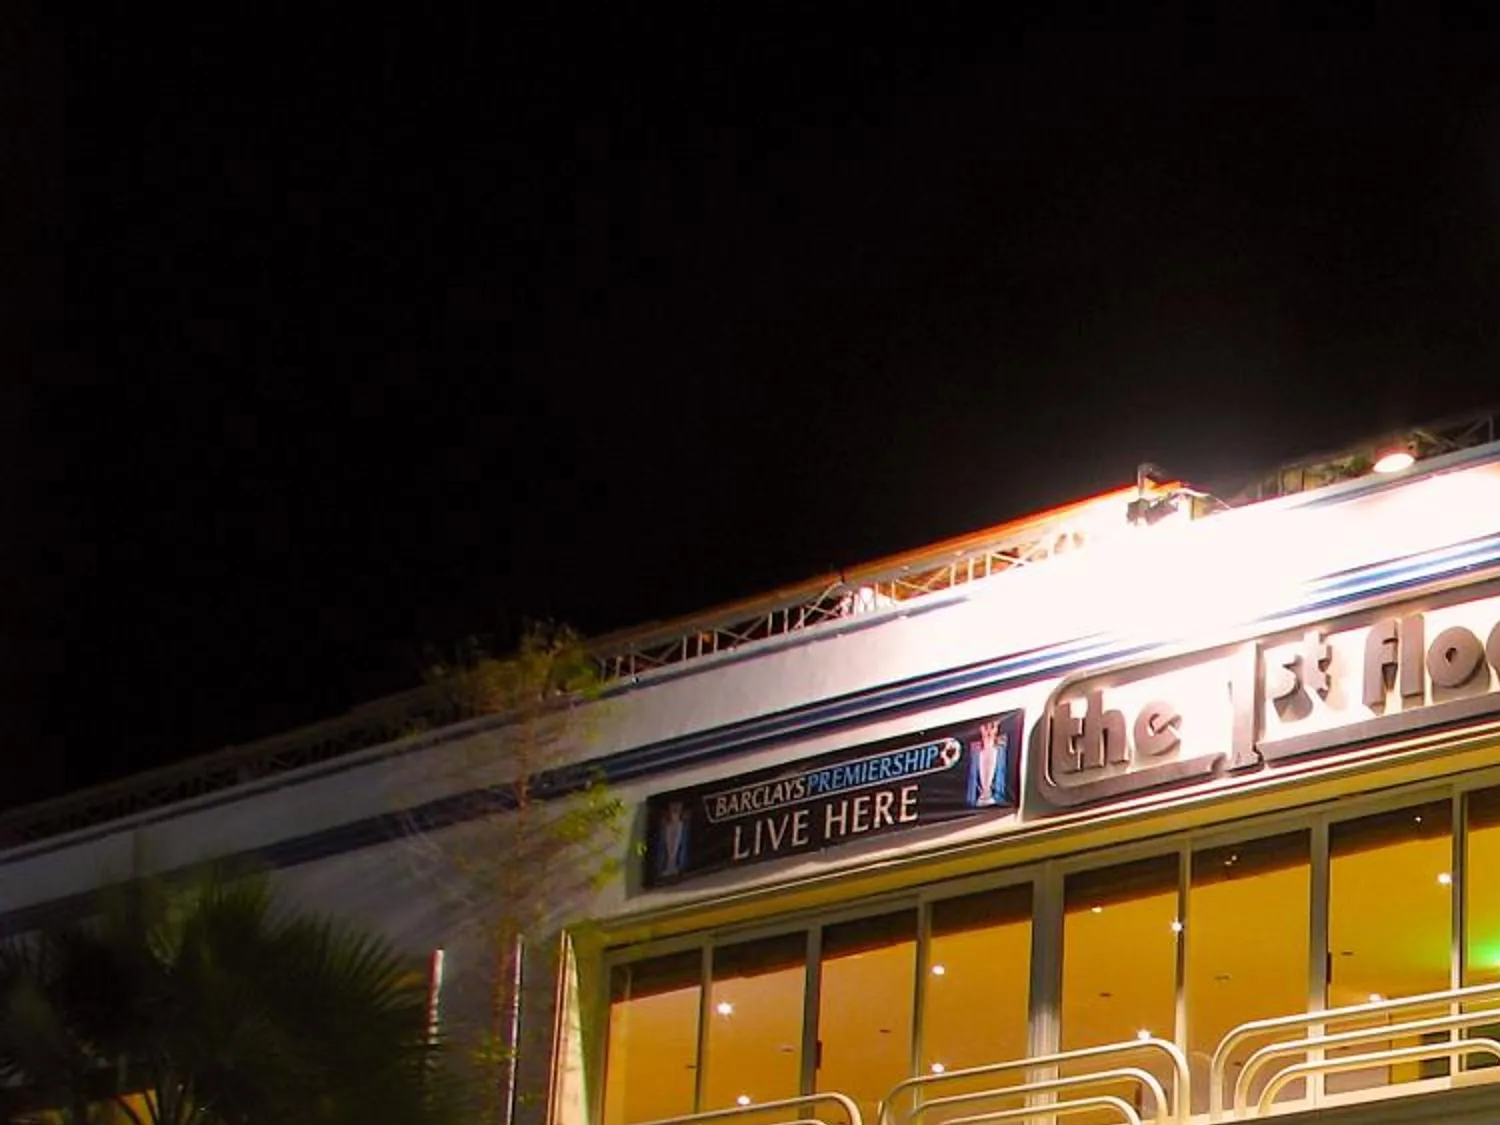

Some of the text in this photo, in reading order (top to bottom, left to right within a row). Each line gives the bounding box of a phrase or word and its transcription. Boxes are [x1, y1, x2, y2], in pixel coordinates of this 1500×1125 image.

[1051, 689, 1182, 775] the
[1224, 631, 1332, 771] 1st
[733, 785, 919, 860] LIVE HERE
